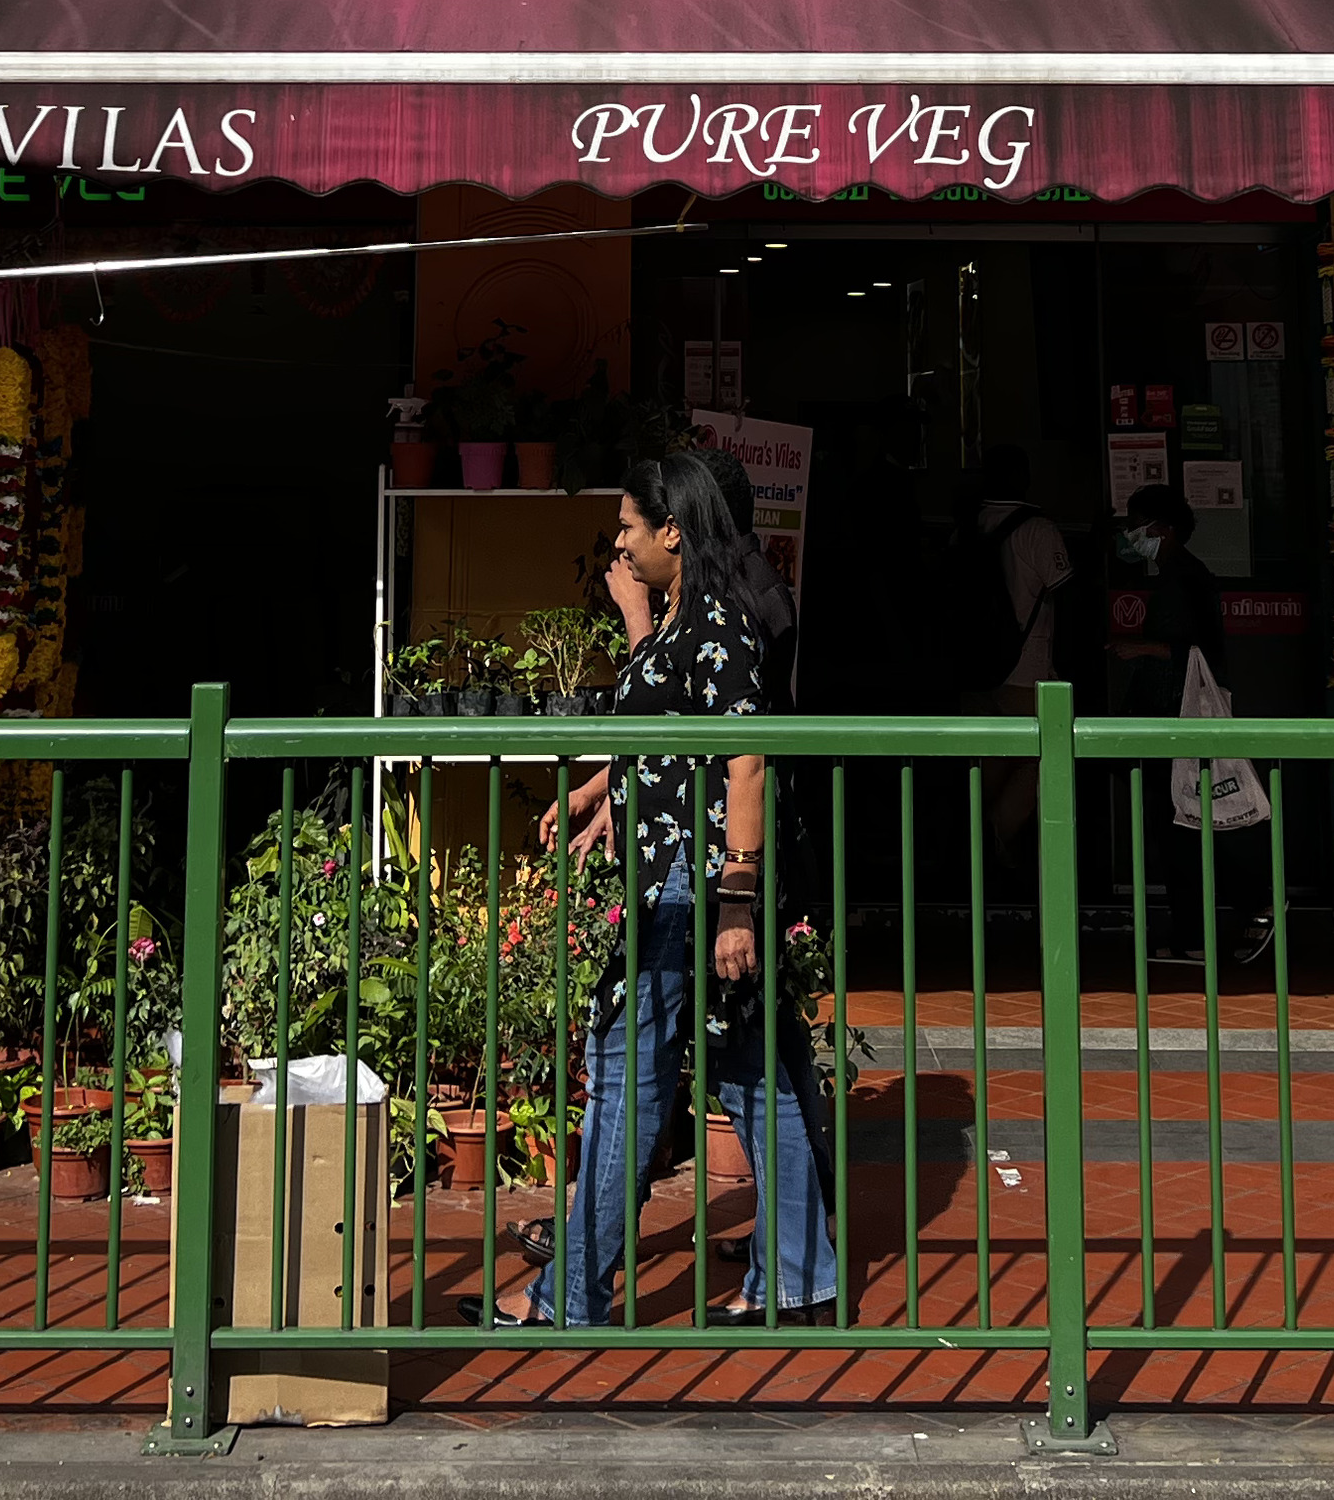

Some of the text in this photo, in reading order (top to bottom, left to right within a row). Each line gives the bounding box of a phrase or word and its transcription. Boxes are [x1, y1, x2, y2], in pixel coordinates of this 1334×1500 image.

[571, 93, 1035, 190] PURE VEG
[722, 437, 802, 470] Madura's Vilas
[754, 510, 780, 526] RIAN
